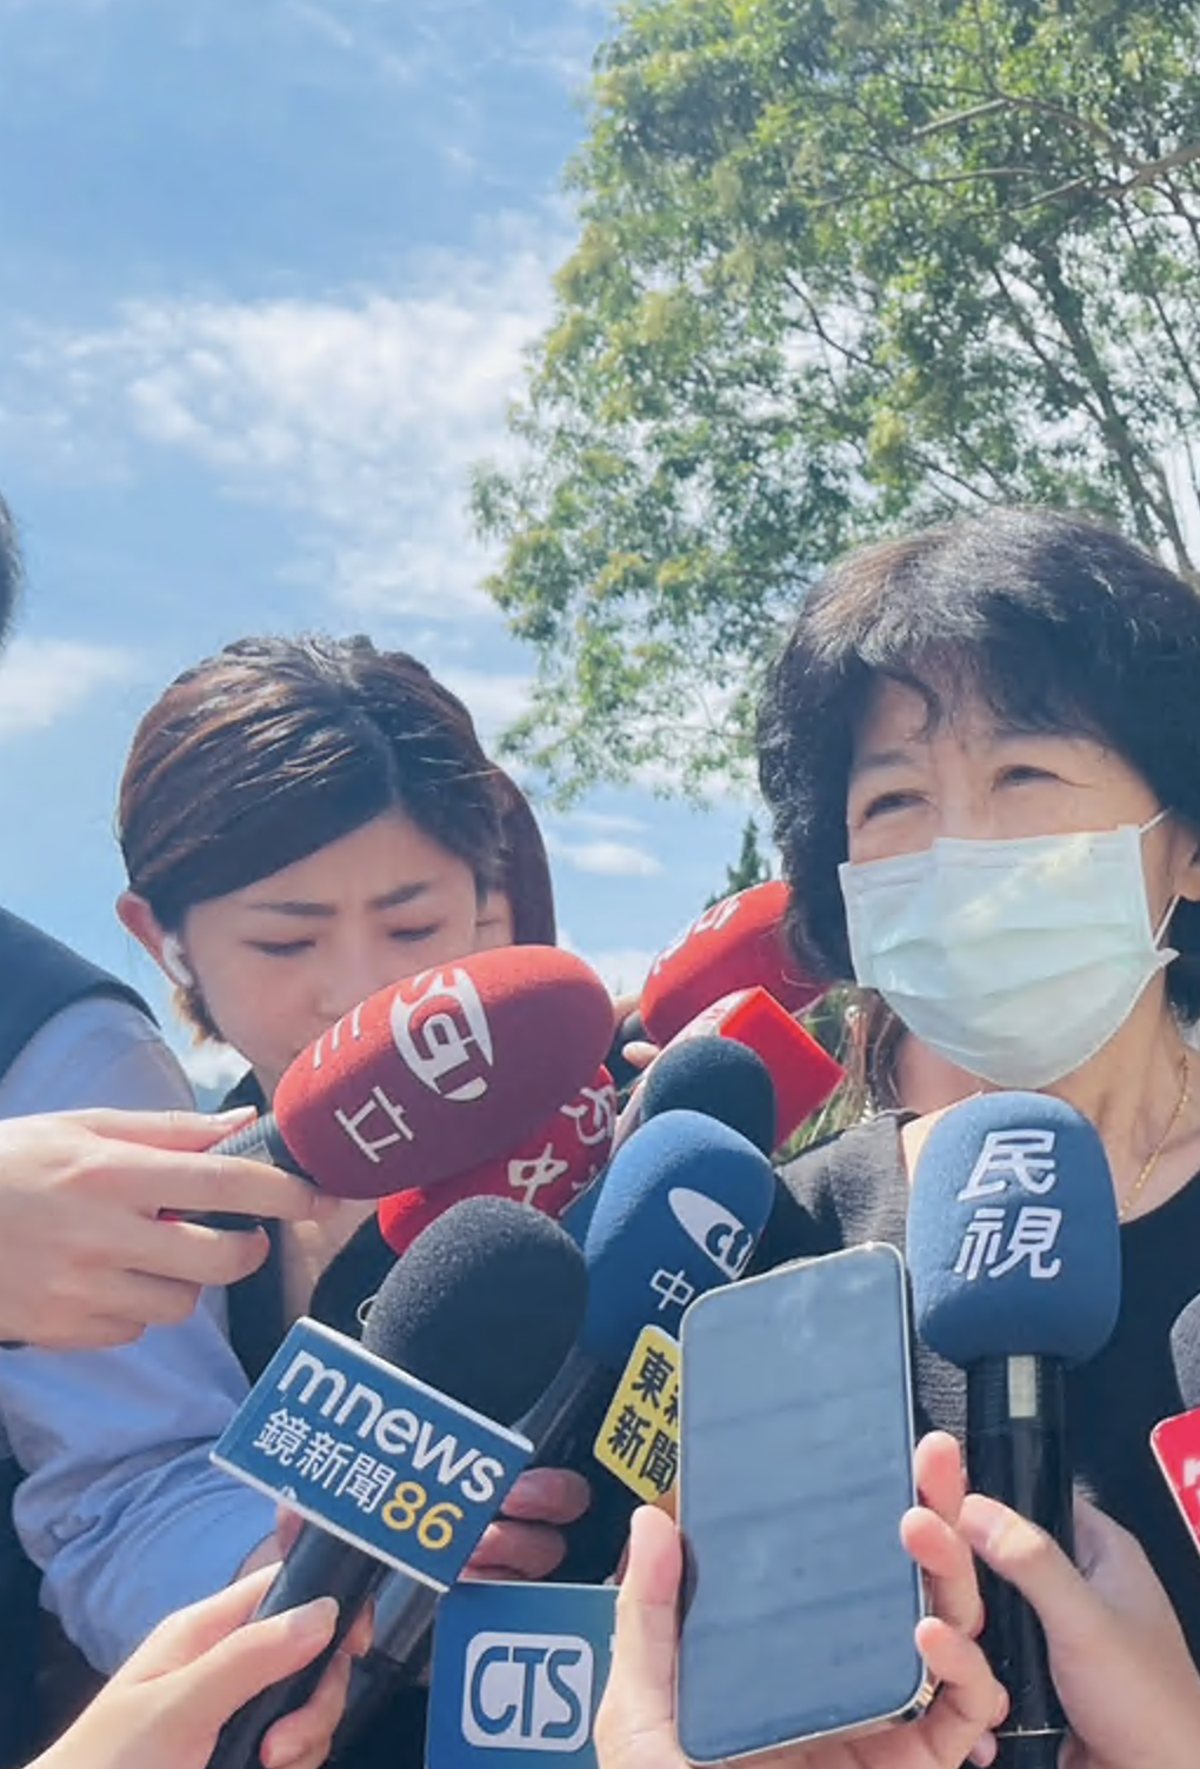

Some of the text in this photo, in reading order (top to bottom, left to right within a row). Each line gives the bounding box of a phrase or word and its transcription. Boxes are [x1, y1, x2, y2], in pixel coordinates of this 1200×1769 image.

[953, 1128, 1063, 1280] 民視
[277, 1349, 505, 1503] mnews
[607, 1403, 679, 1495] 新聞
[470, 1646, 582, 1740] CTS
